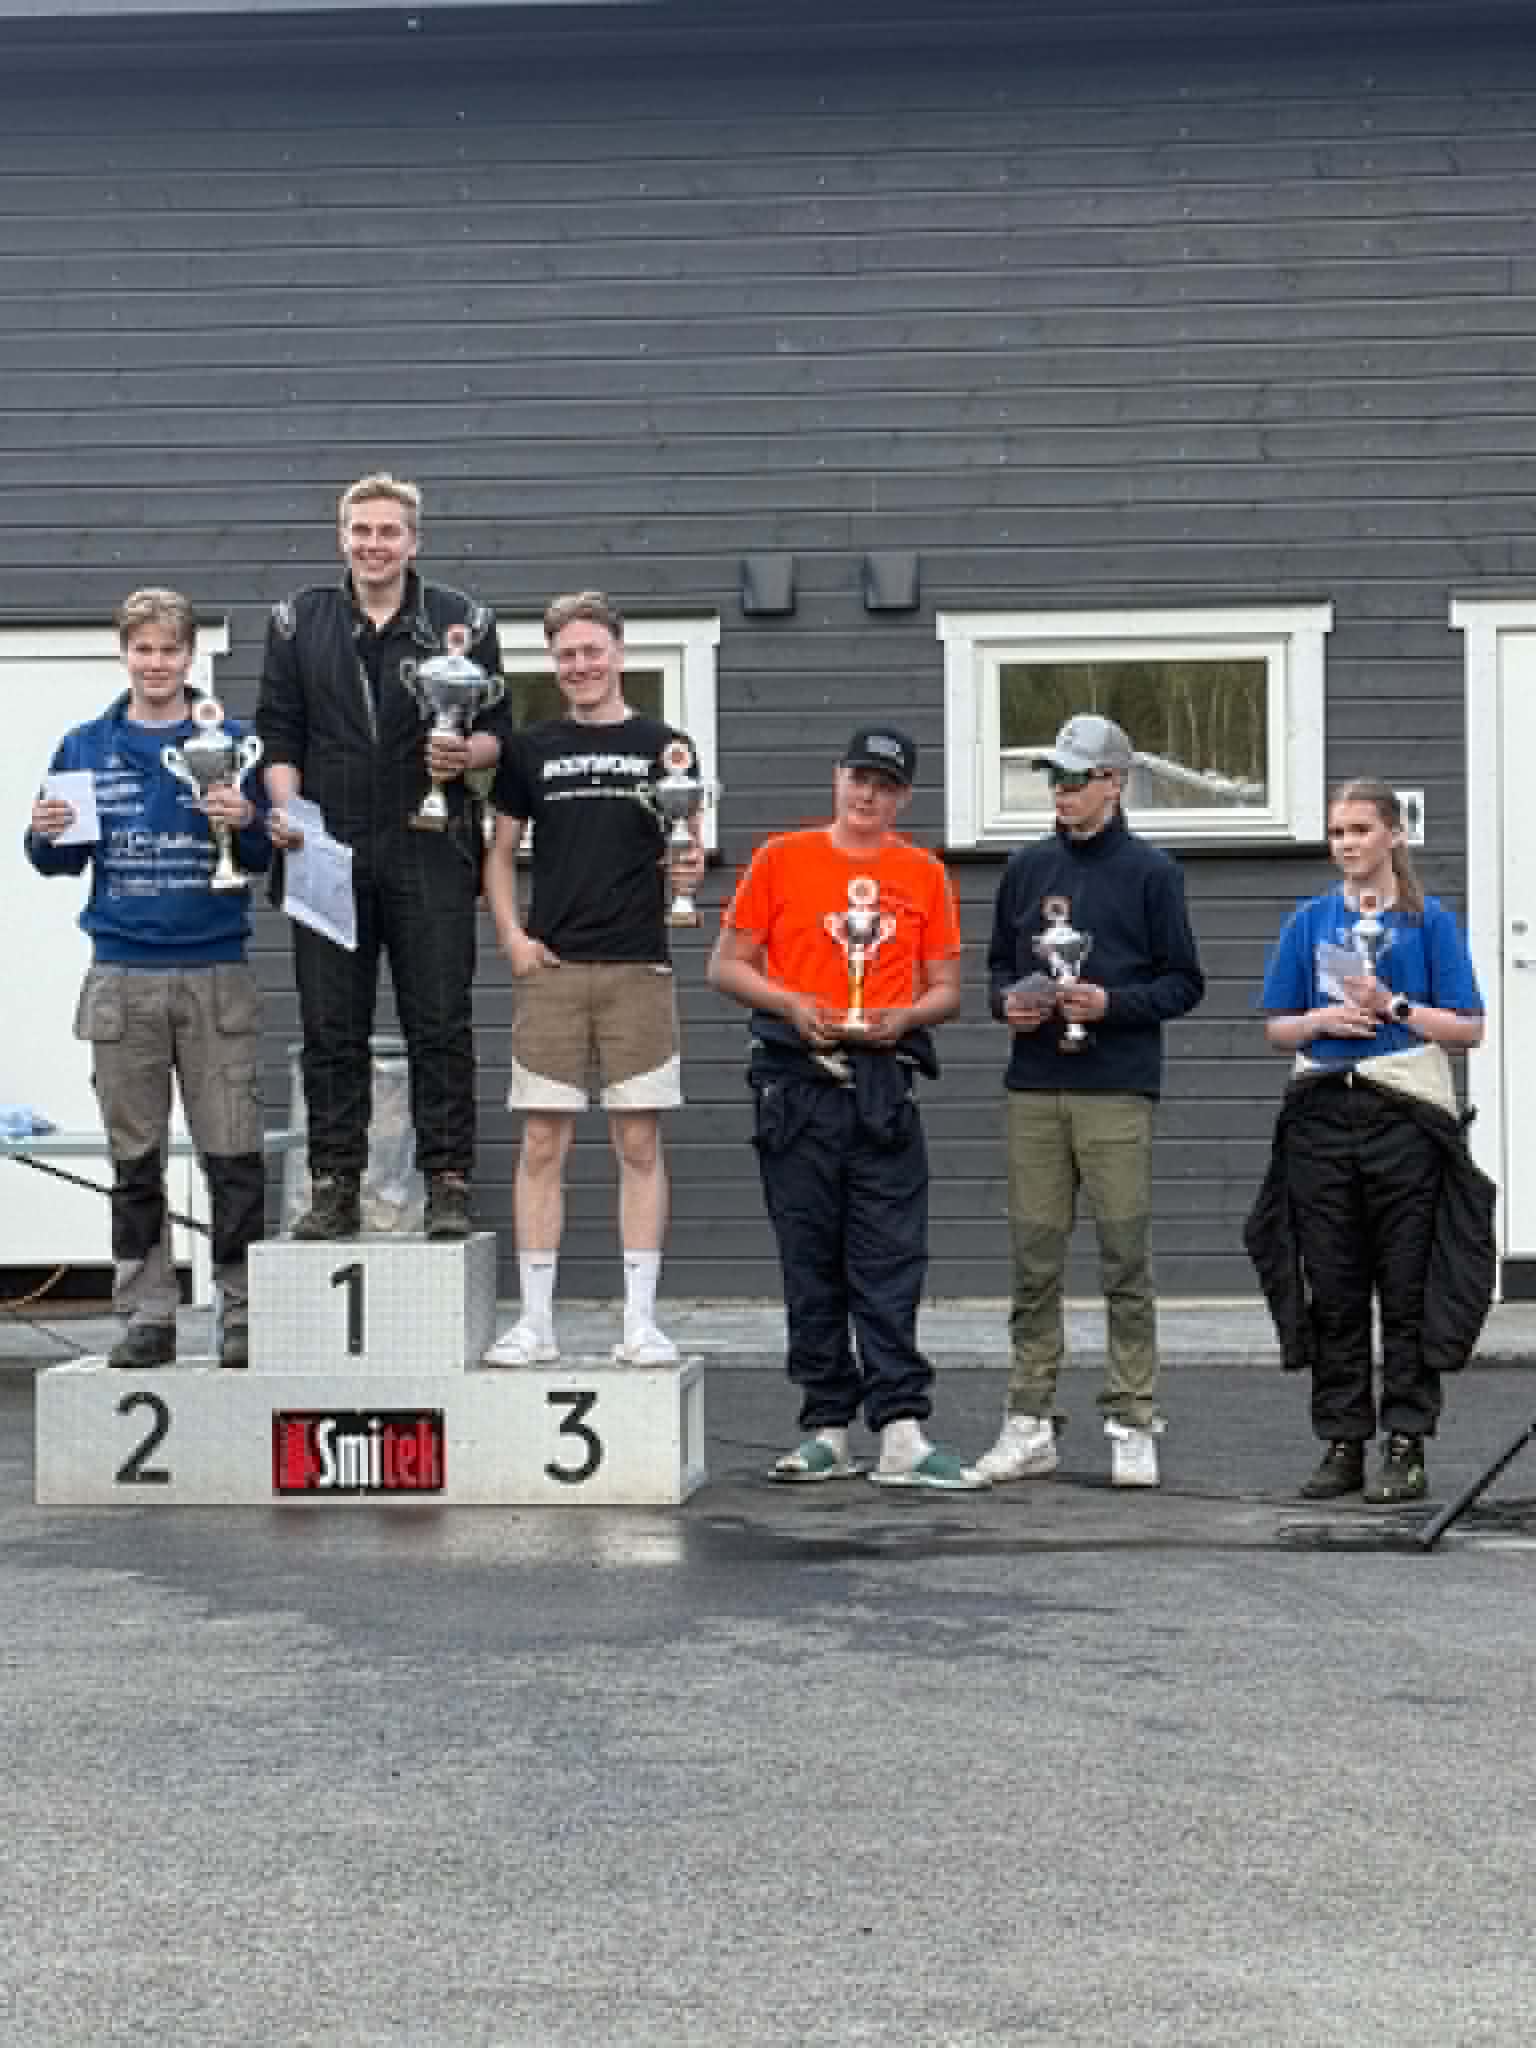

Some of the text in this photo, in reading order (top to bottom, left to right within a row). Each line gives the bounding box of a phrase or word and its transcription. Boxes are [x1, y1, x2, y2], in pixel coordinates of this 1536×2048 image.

[330, 1263, 366, 1356] 1
[115, 1391, 171, 1484] 2
[544, 1391, 603, 1484] 3
